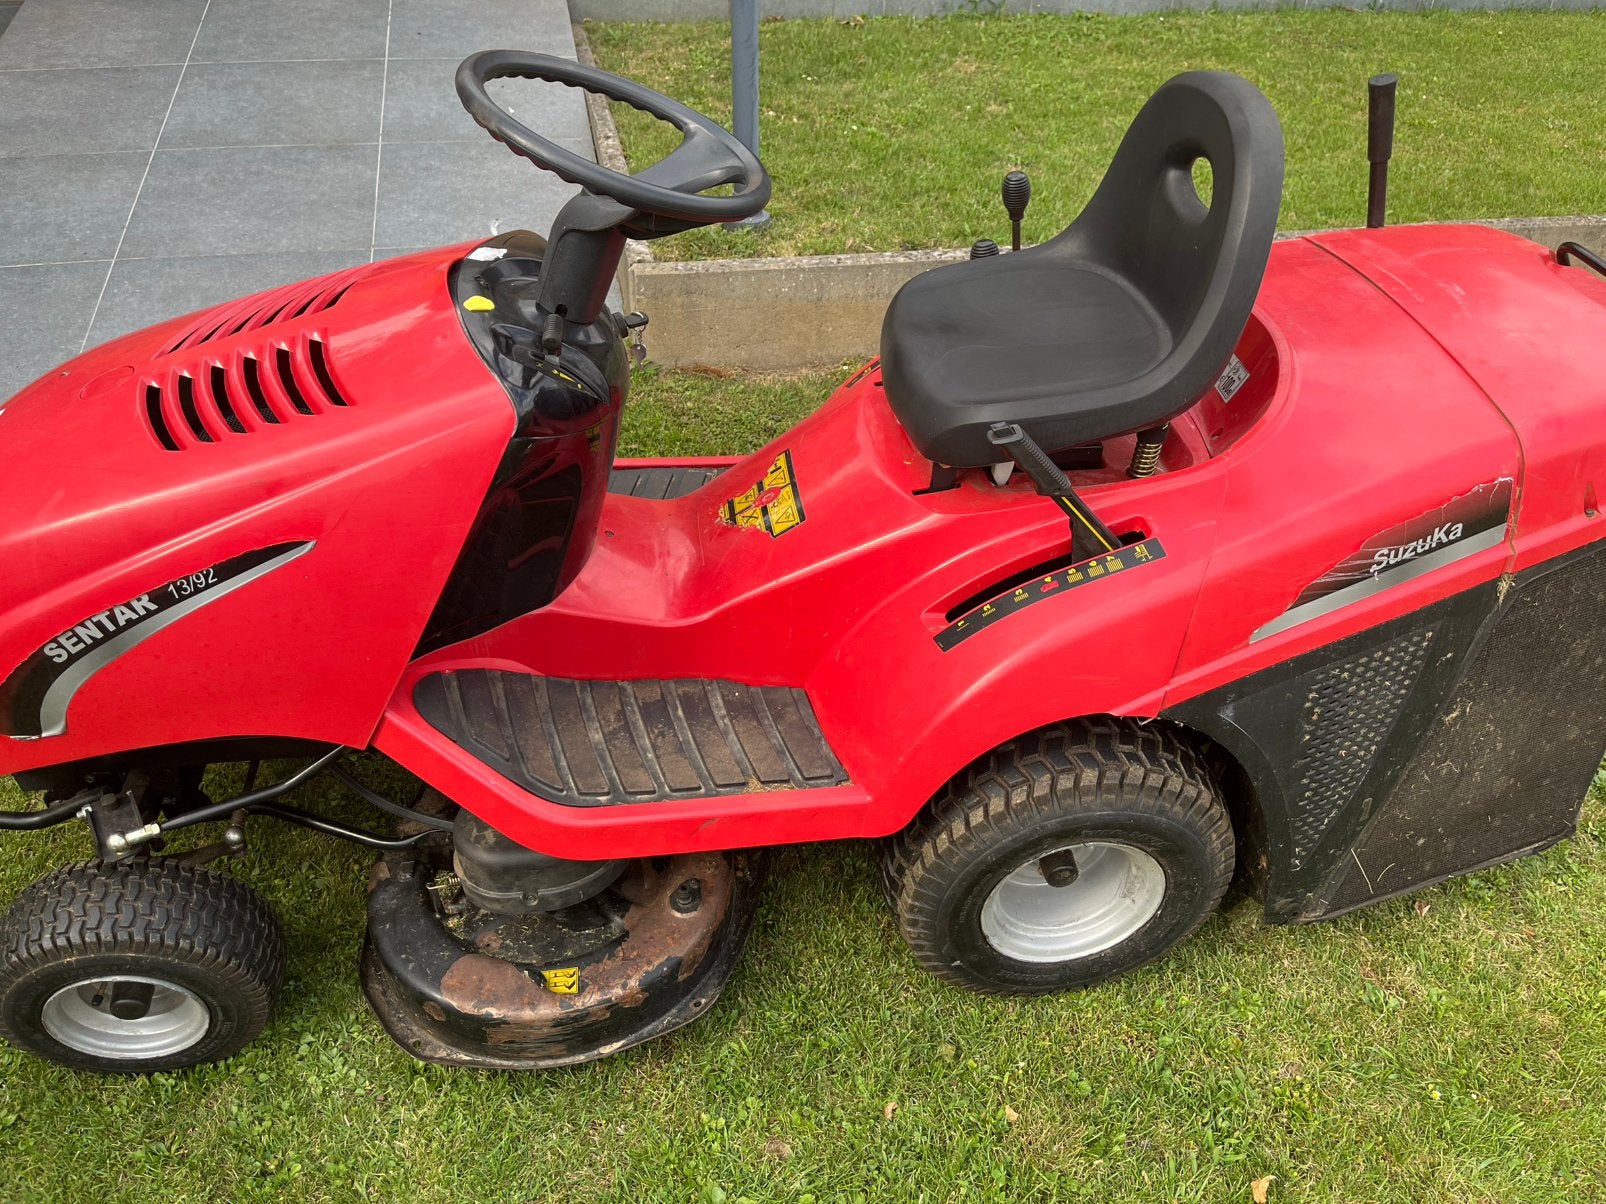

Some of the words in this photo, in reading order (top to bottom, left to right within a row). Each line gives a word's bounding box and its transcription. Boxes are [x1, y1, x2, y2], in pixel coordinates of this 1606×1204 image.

[1370, 522, 1464, 573] SuzuKa
[983, 603, 991, 611] 2
[1015, 588, 1023, 596] 3
[1068, 567, 1077, 575] 5
[43, 593, 159, 663] SENTAR
[167, 567, 218, 599] 13/92
